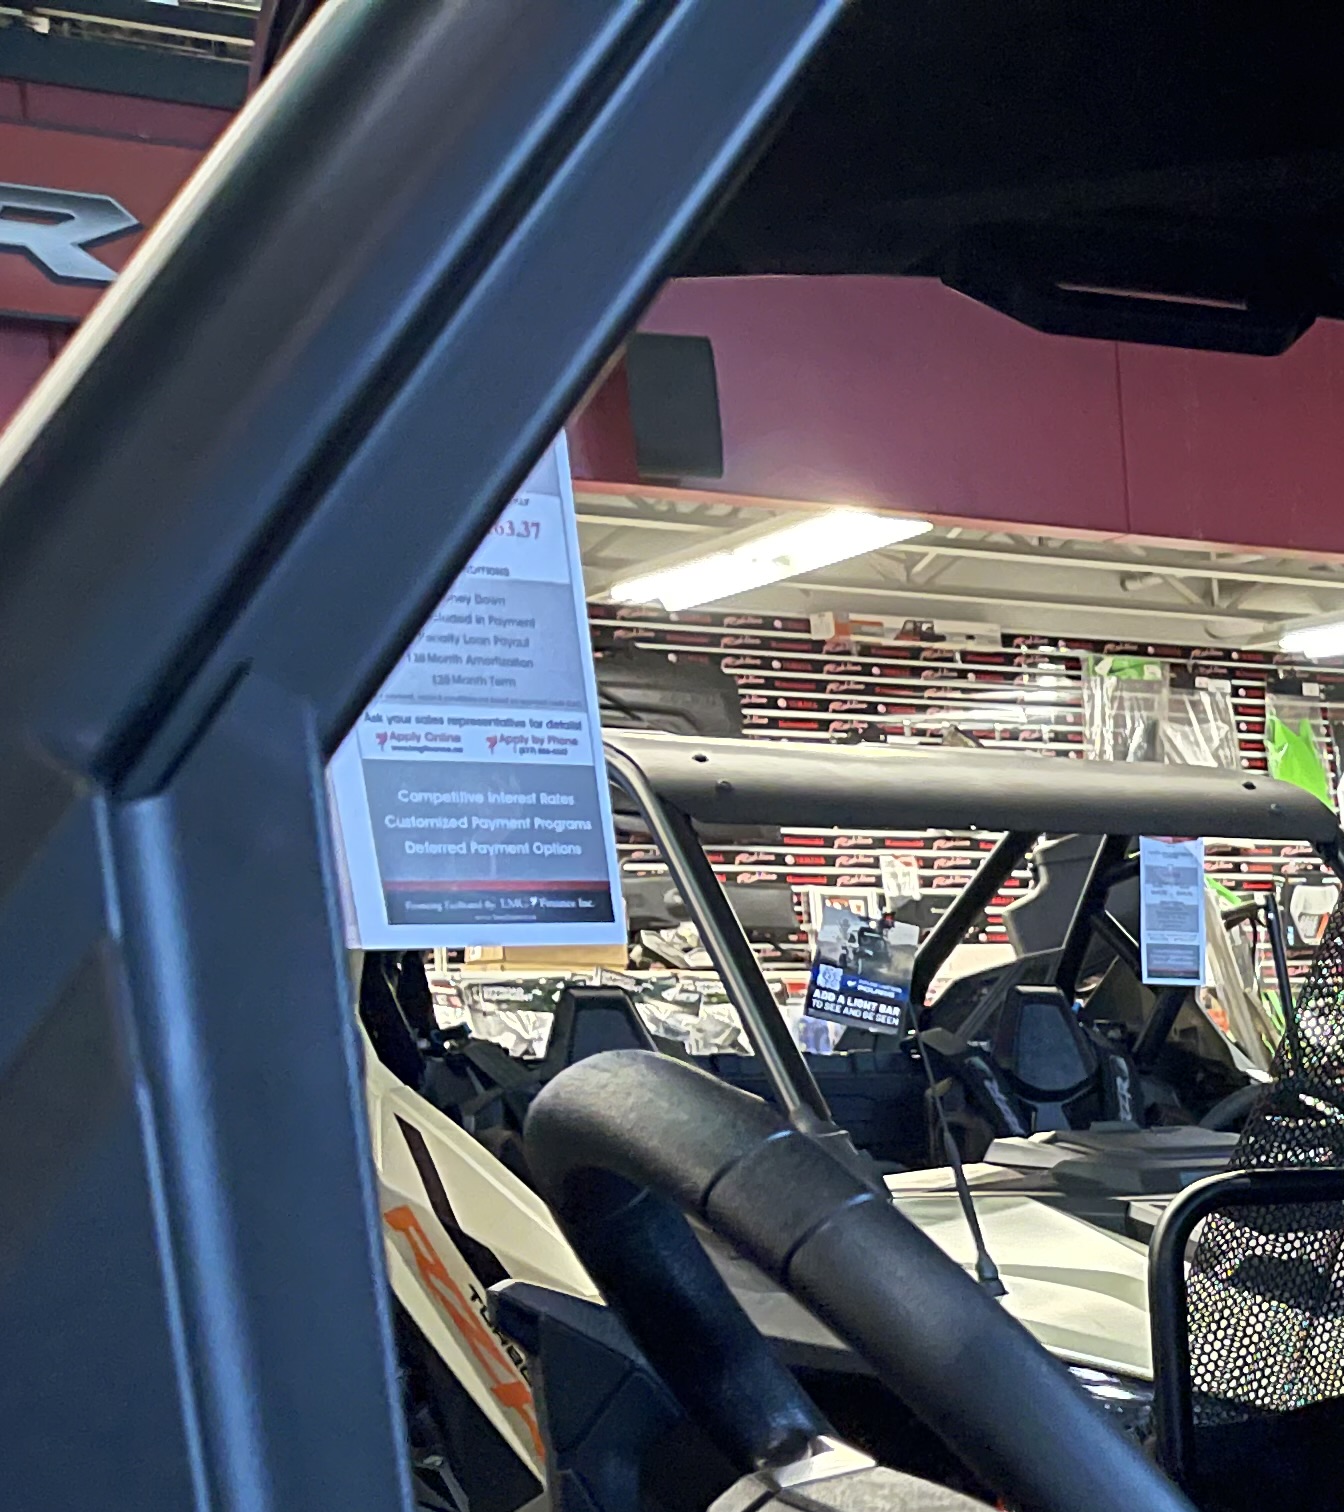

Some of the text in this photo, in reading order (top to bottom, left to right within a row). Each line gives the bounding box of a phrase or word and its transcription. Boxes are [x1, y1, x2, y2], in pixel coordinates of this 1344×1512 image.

[488, 615, 536, 629] Payment
[427, 652, 463, 664] Month
[465, 654, 534, 668] Amortization
[452, 674, 487, 686] Month
[489, 675, 517, 687] Term
[389, 730, 462, 743] Apply Online
[498, 733, 529, 746] Apply
[397, 789, 575, 806] Competitive Interest Rates
[384, 814, 593, 832] Customized Payment Programs
[404, 840, 583, 858] Deferred Payment Options
[812, 988, 901, 1017] ADD A LIGHT BAR
[811, 998, 900, 1026] TO SEE AND BE SEEN
